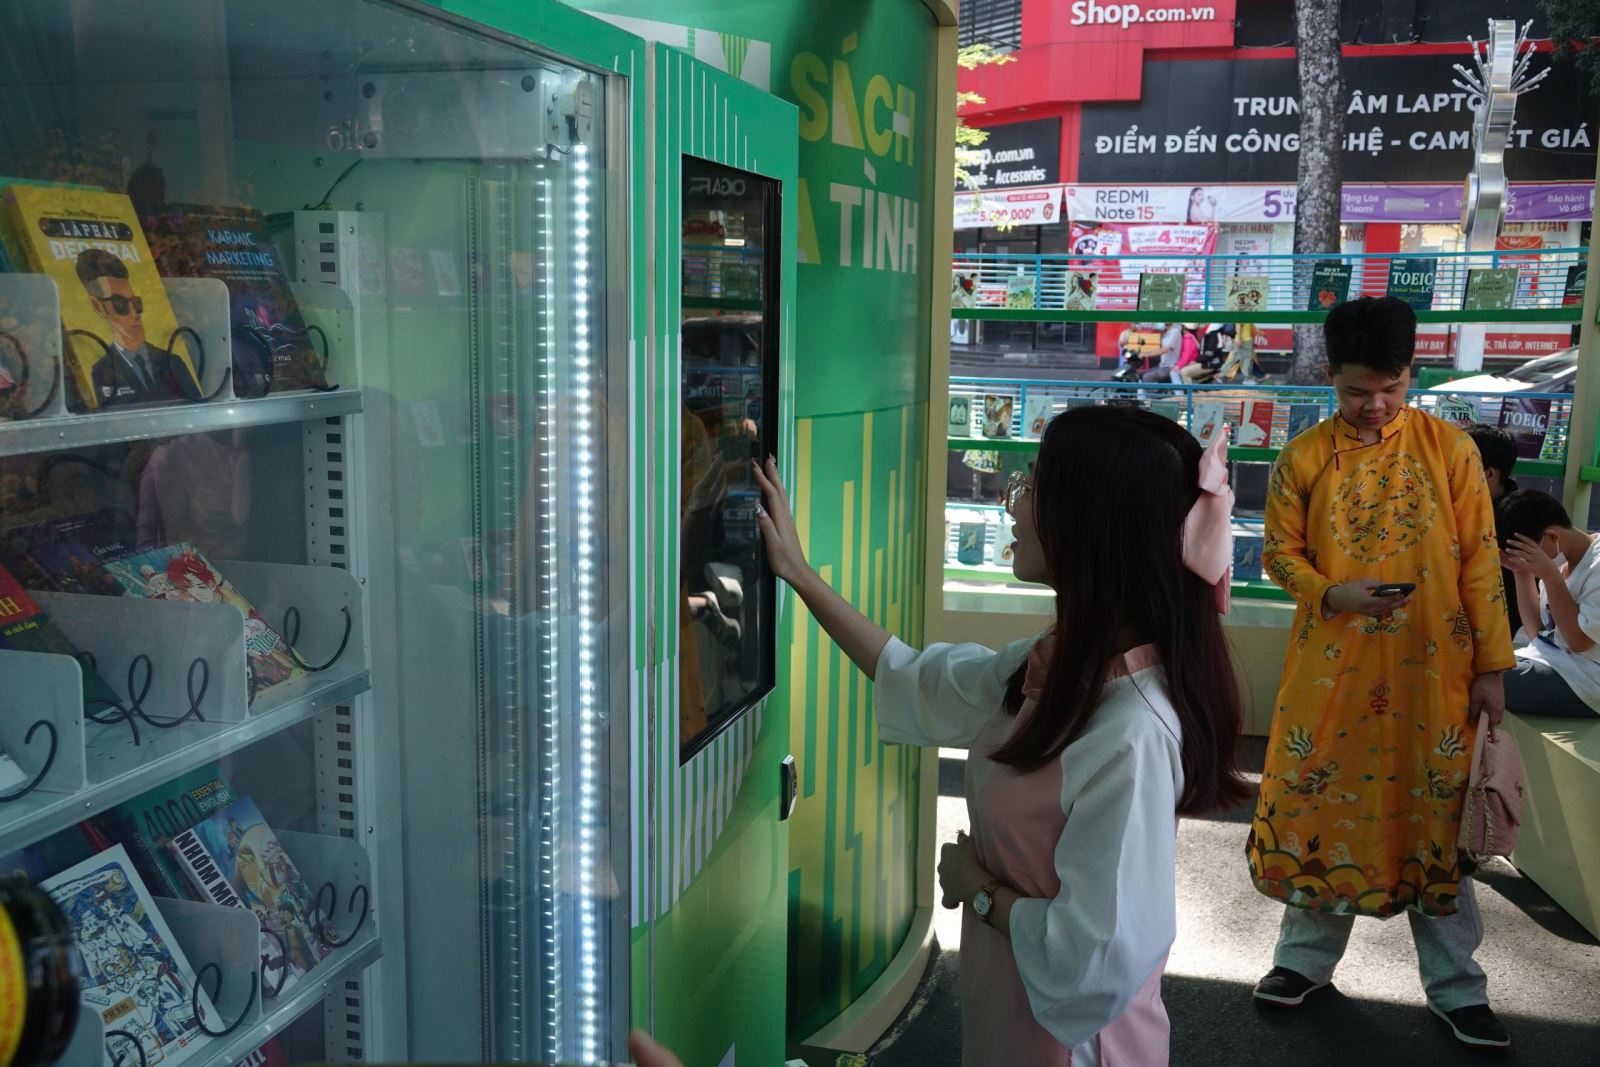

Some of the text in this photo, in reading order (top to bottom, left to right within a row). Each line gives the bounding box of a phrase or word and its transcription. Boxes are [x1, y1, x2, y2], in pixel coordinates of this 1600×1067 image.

[790, 31, 915, 166] SÁCH
[1234, 97, 1299, 116] TRUN
[1347, 90, 1388, 114] ÂM
[1095, 124, 1157, 154] ĐIỂM
[1165, 126, 1217, 153] ĐẾN
[1409, 131, 1469, 150] CAM
[1541, 122, 1591, 148] GIÁ
[1095, 190, 1149, 203] REDMI
[1264, 190, 1281, 218] 5
[830, 156, 919, 274] TÌNH
[1095, 206, 1154, 220] Note 15
[1346, 204, 1374, 213] Xiaomi
[208, 229, 256, 246] KARMIC
[1158, 230, 1171, 244] 4
[207, 251, 274, 267] MARKETING
[1392, 271, 1433, 286] TOEIC
[1442, 411, 1470, 420] FAIR
[1503, 411, 1546, 428] TOEIC
[191, 778, 225, 800] ESSENTIAL
[199, 790, 231, 811] ENGLISH
[174, 831, 221, 886] NHÓM
